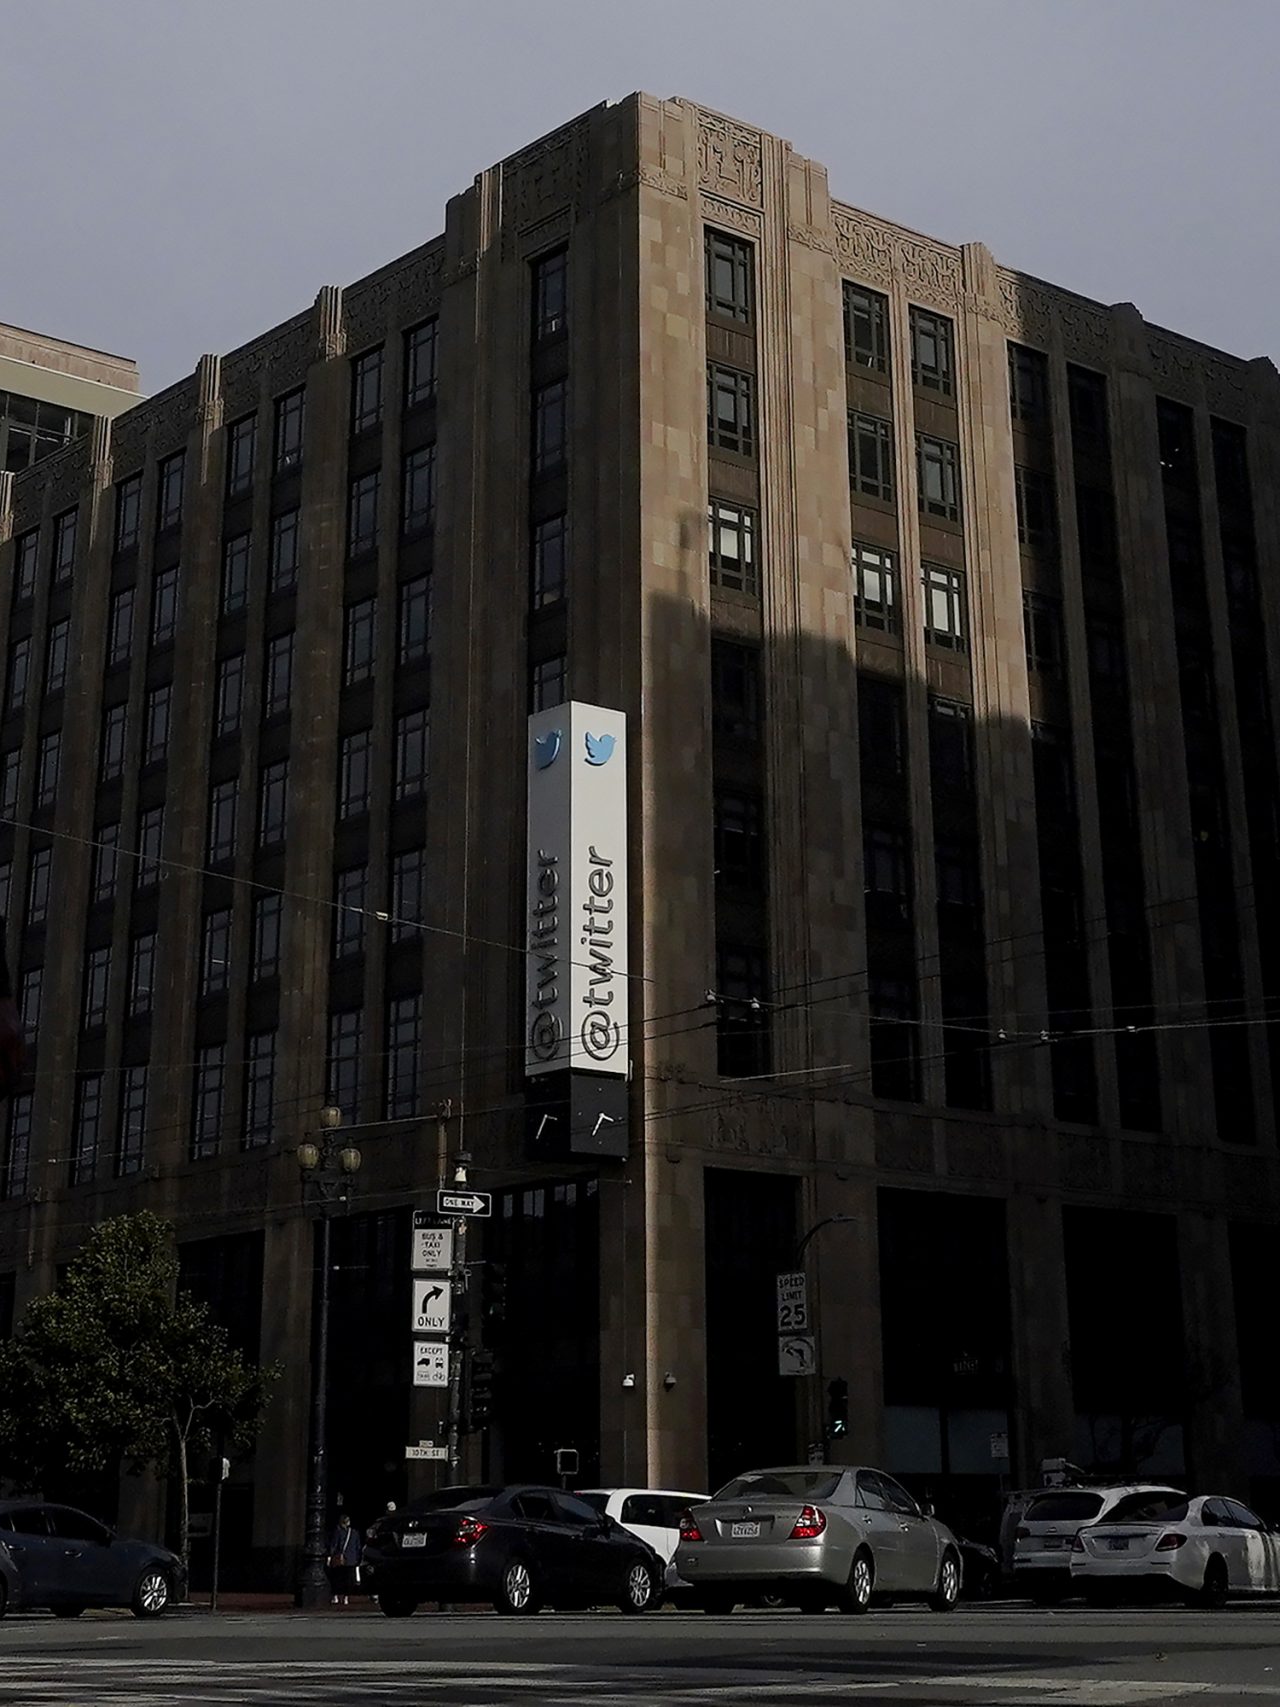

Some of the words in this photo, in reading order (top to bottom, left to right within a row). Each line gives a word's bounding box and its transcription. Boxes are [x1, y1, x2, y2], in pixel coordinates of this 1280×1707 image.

[531, 848, 564, 1061] @twitter
[581, 845, 620, 1061] @twitter
[422, 1249, 442, 1258] ONLY
[779, 1276, 805, 1289] SPEED
[782, 1290, 802, 1302] LIMIT
[780, 1303, 806, 1327] 25
[417, 1316, 445, 1328] ONLY
[420, 1346, 443, 1355] EXCEPT
